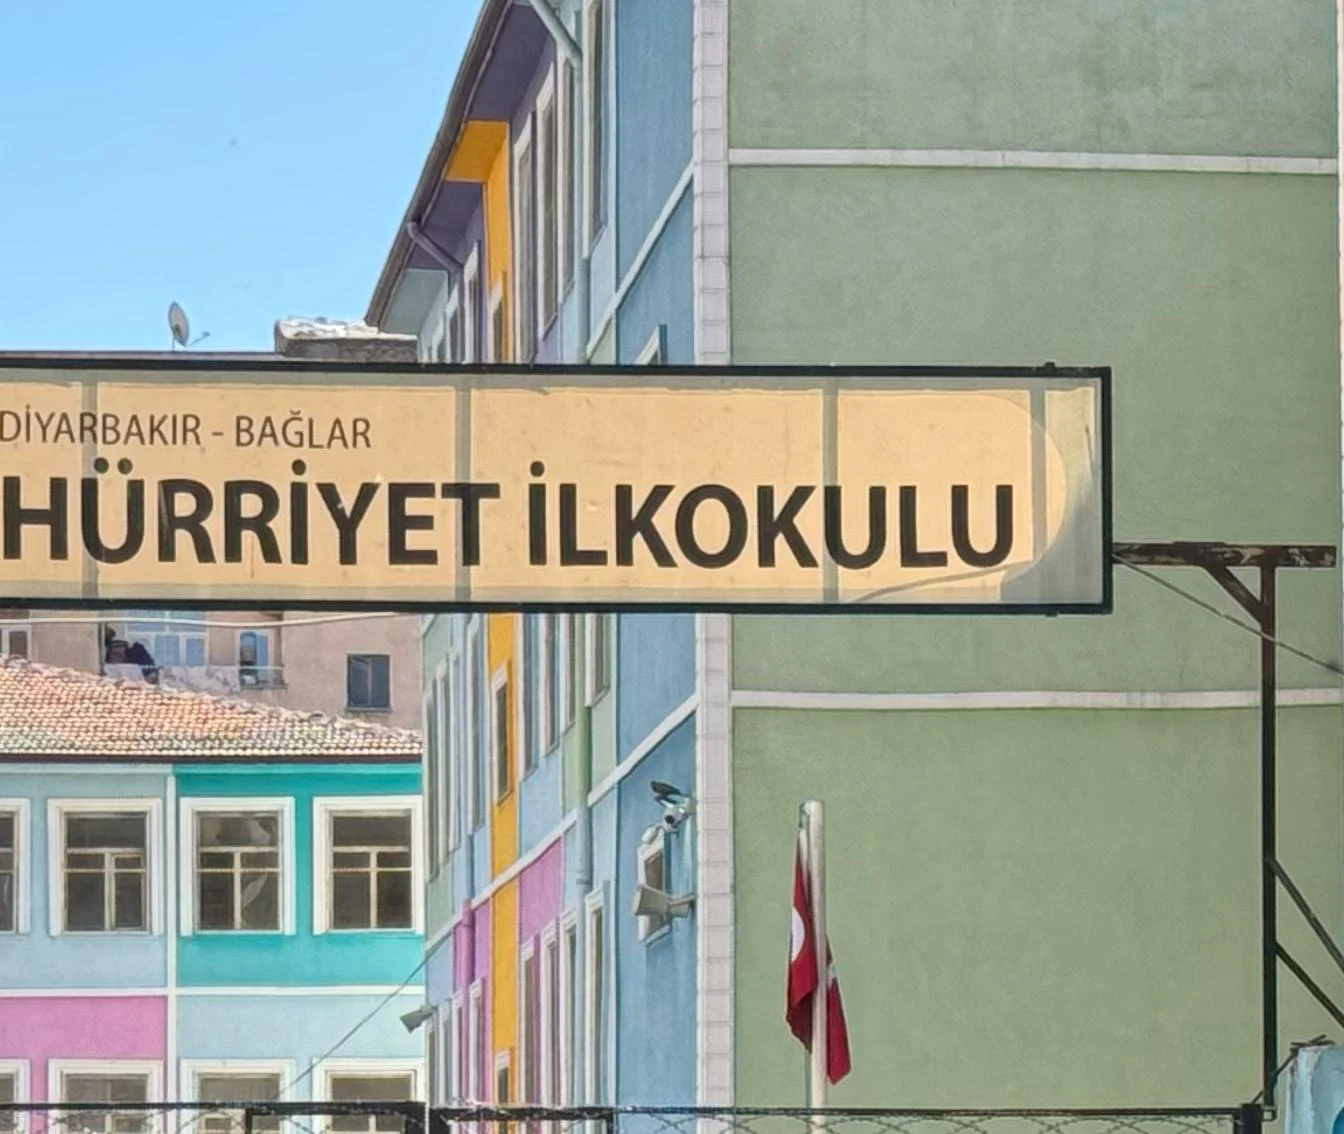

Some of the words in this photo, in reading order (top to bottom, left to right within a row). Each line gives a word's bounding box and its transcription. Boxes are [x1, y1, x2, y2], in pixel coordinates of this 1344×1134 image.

[234, 409, 372, 451] BAĞLAR
[2, 456, 501, 567] HÜRRİYET
[527, 460, 1014, 570] İLKOKULU
